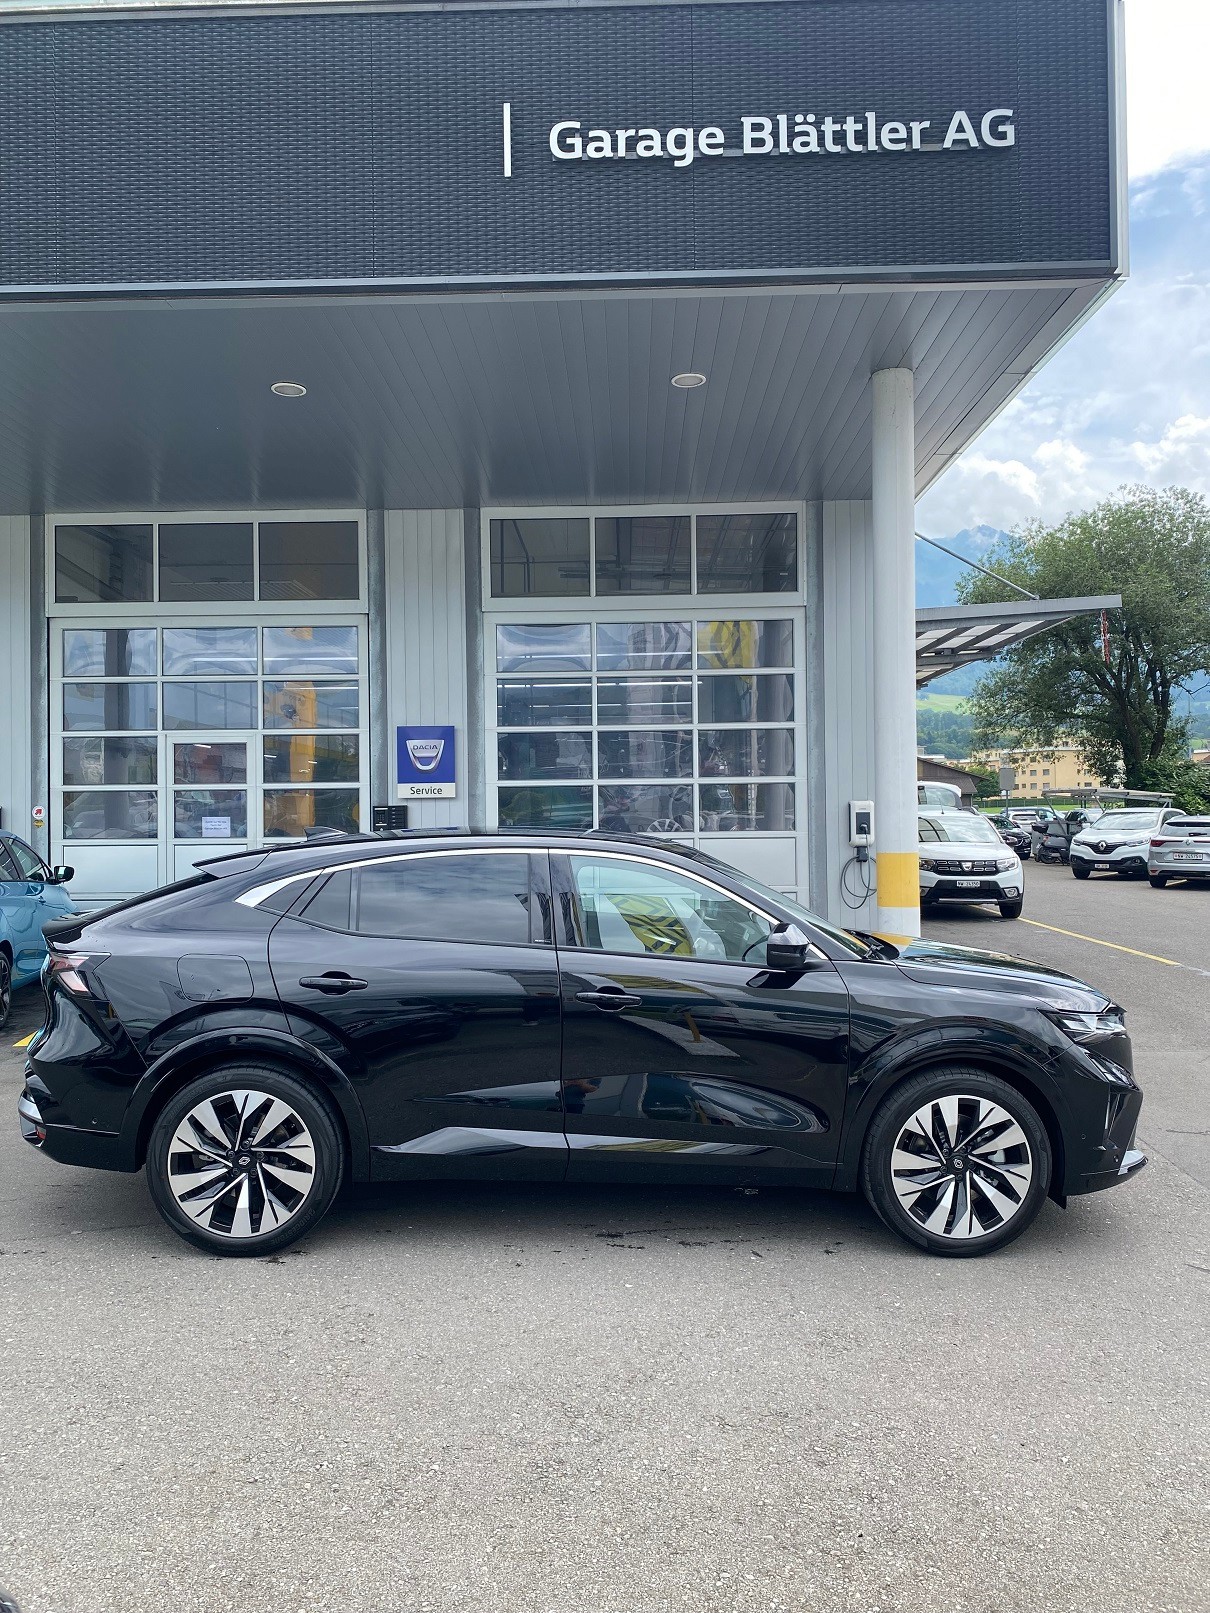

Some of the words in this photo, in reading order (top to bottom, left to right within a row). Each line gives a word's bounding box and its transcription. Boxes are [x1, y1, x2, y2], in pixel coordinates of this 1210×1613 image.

[549, 120, 726, 168] Garage
[741, 111, 931, 155] Blättler
[942, 108, 1016, 149] AG
[410, 786, 443, 795] Service
